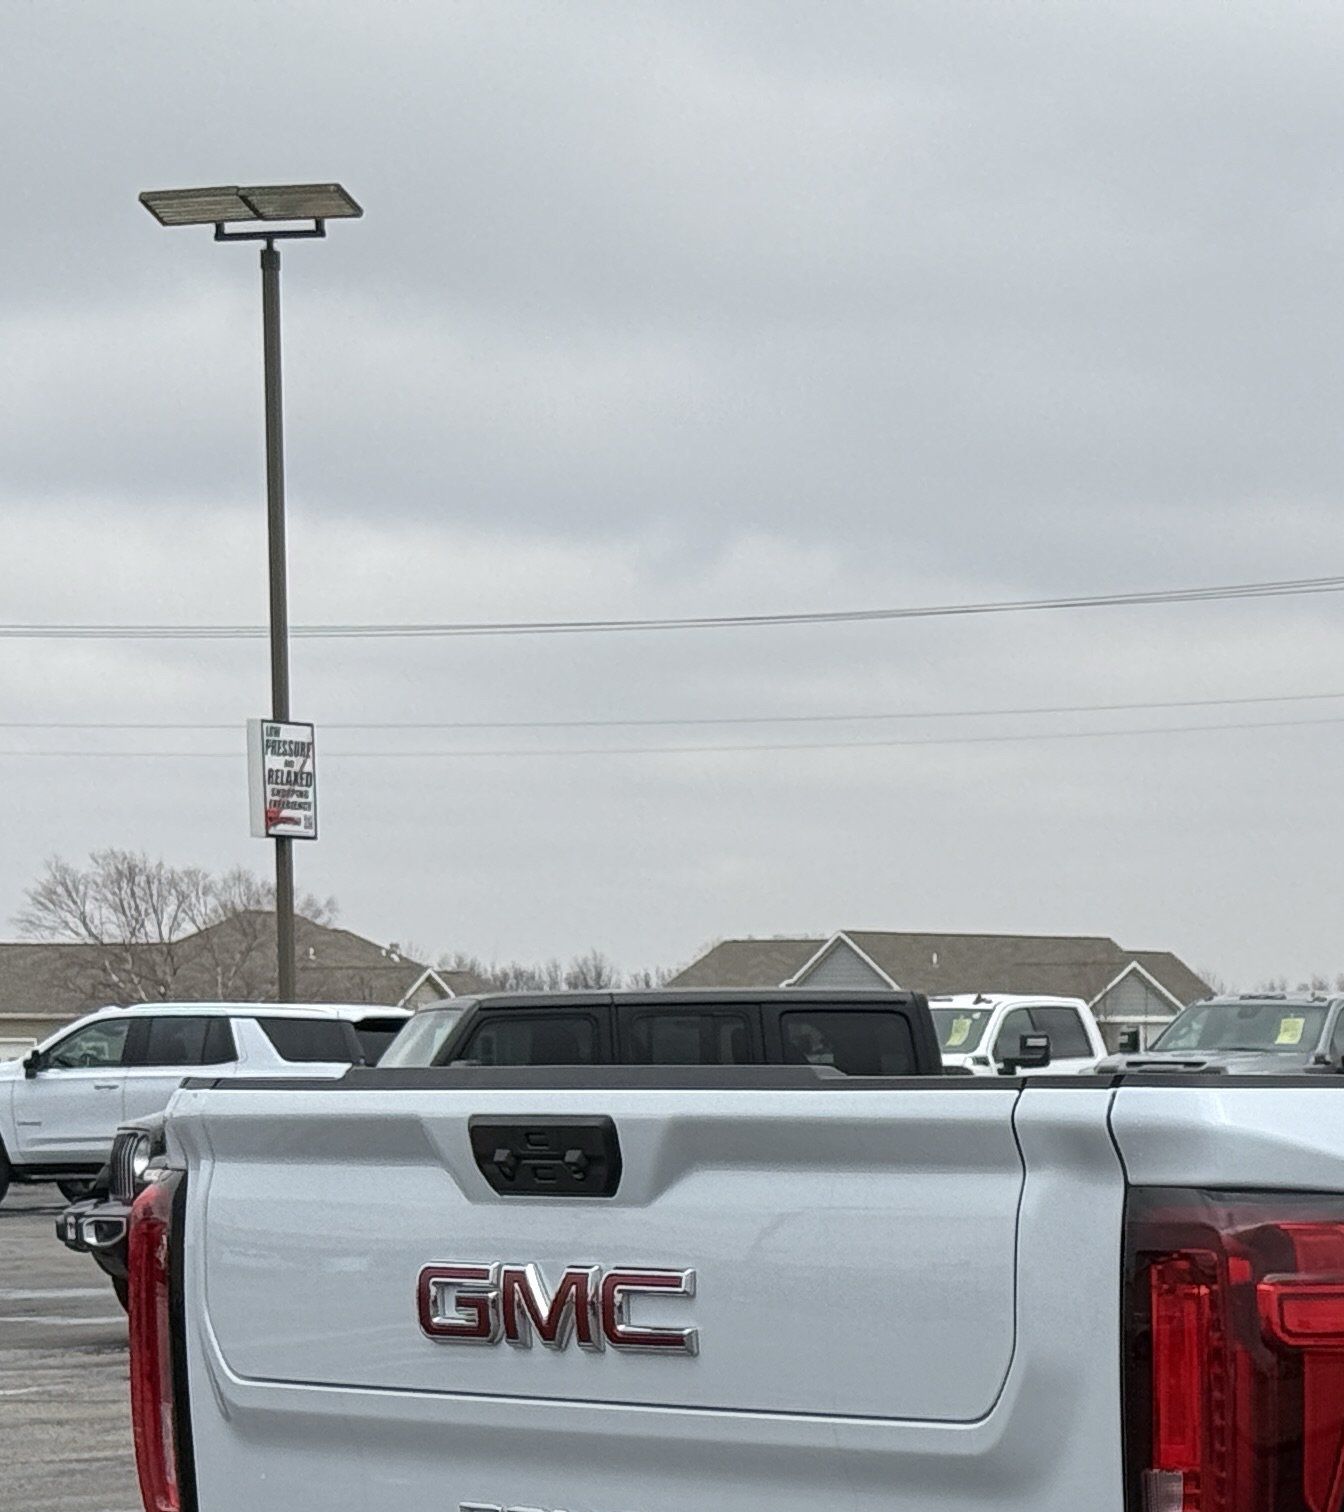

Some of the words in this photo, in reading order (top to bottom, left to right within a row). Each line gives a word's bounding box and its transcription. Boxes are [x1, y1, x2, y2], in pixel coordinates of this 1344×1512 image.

[266, 725, 281, 737] LOW
[265, 740, 312, 758] PRESSURE
[267, 768, 313, 788] RELAXED
[416, 1259, 700, 1357] GMC
